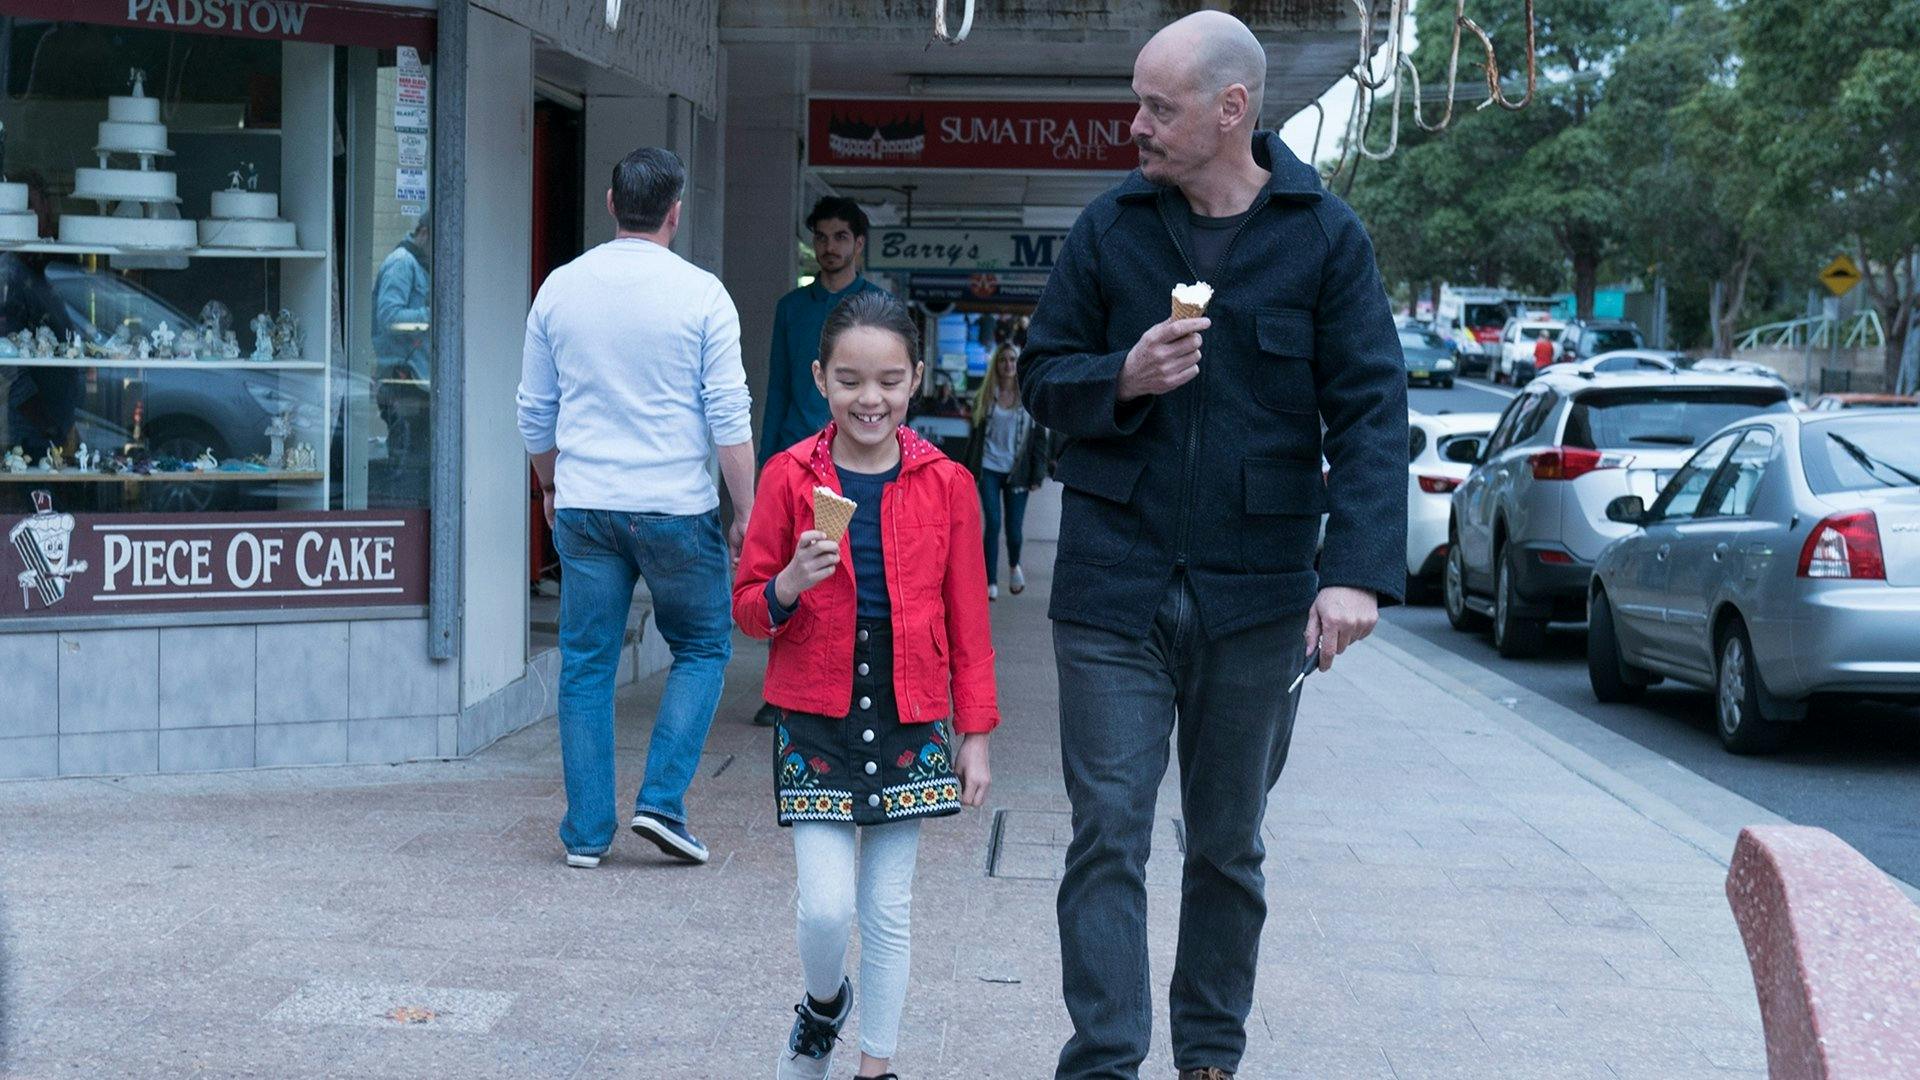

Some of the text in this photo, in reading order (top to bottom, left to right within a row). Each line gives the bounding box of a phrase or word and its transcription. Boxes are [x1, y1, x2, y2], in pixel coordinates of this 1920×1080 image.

[127, 0, 310, 35] PADSTOW
[940, 117, 1081, 144] SUMATRA
[882, 232, 980, 266] Barry's
[103, 531, 395, 591] PIECE OF CAKE
